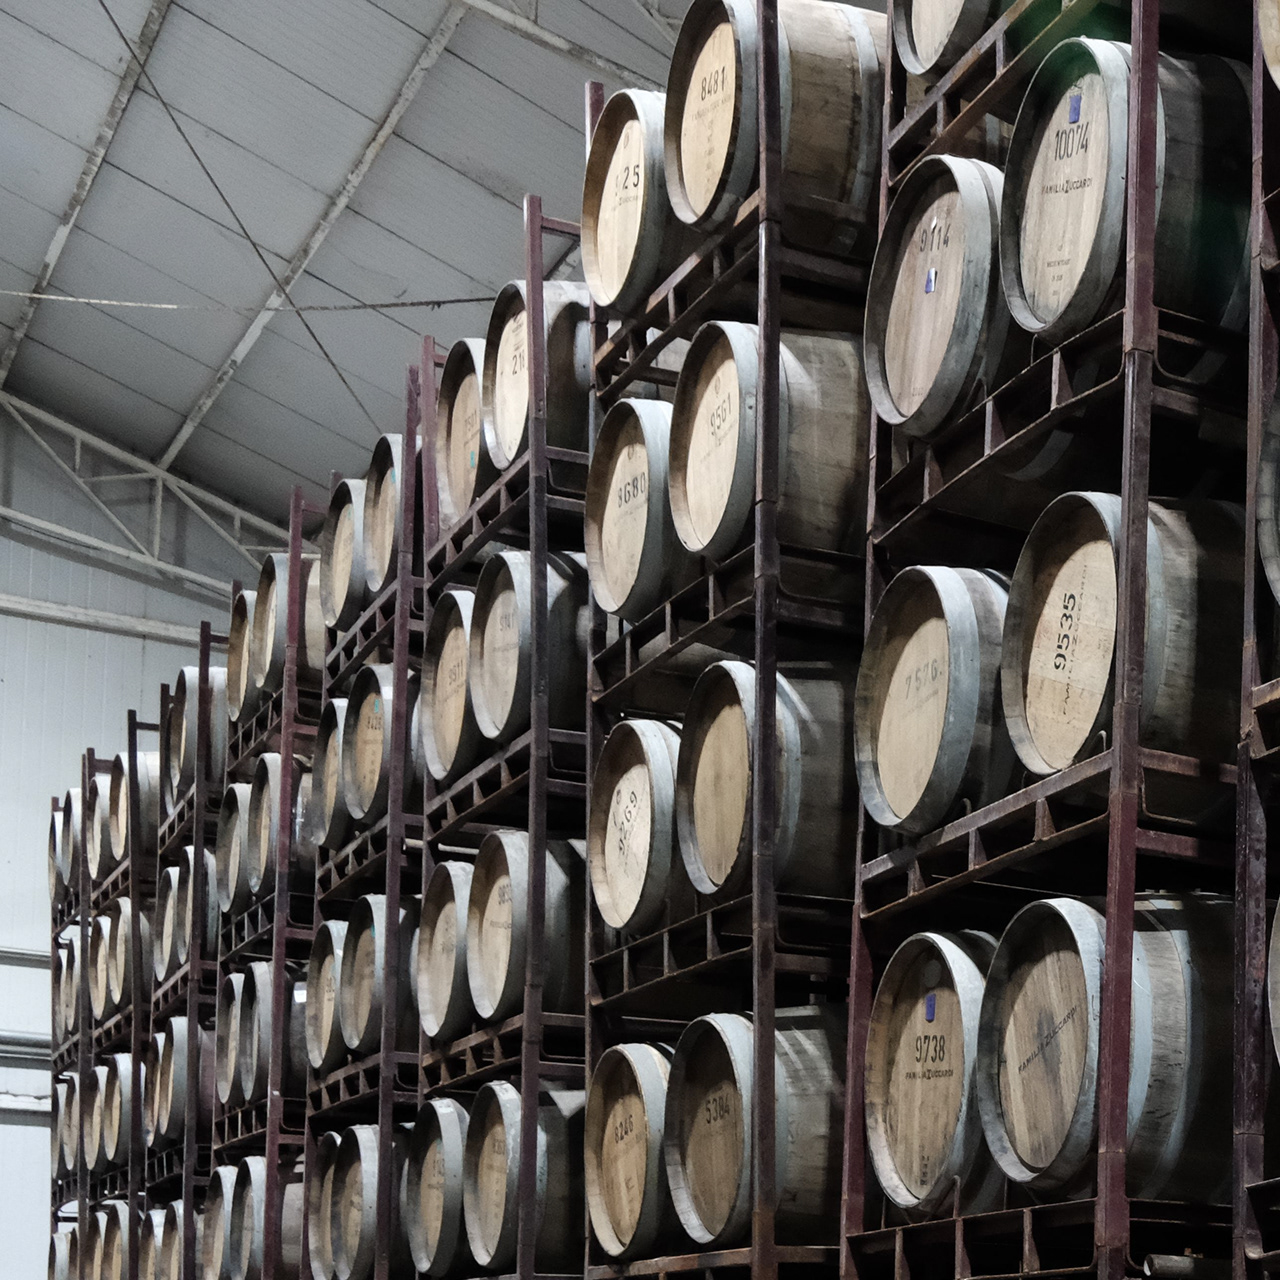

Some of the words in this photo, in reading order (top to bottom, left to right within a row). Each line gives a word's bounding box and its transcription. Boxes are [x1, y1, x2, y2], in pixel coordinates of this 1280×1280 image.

[701, 66, 725, 101] 8481
[1055, 122, 1089, 161] 10074
[1054, 593, 1077, 671] 9535
[915, 1035, 946, 1063] 9738
